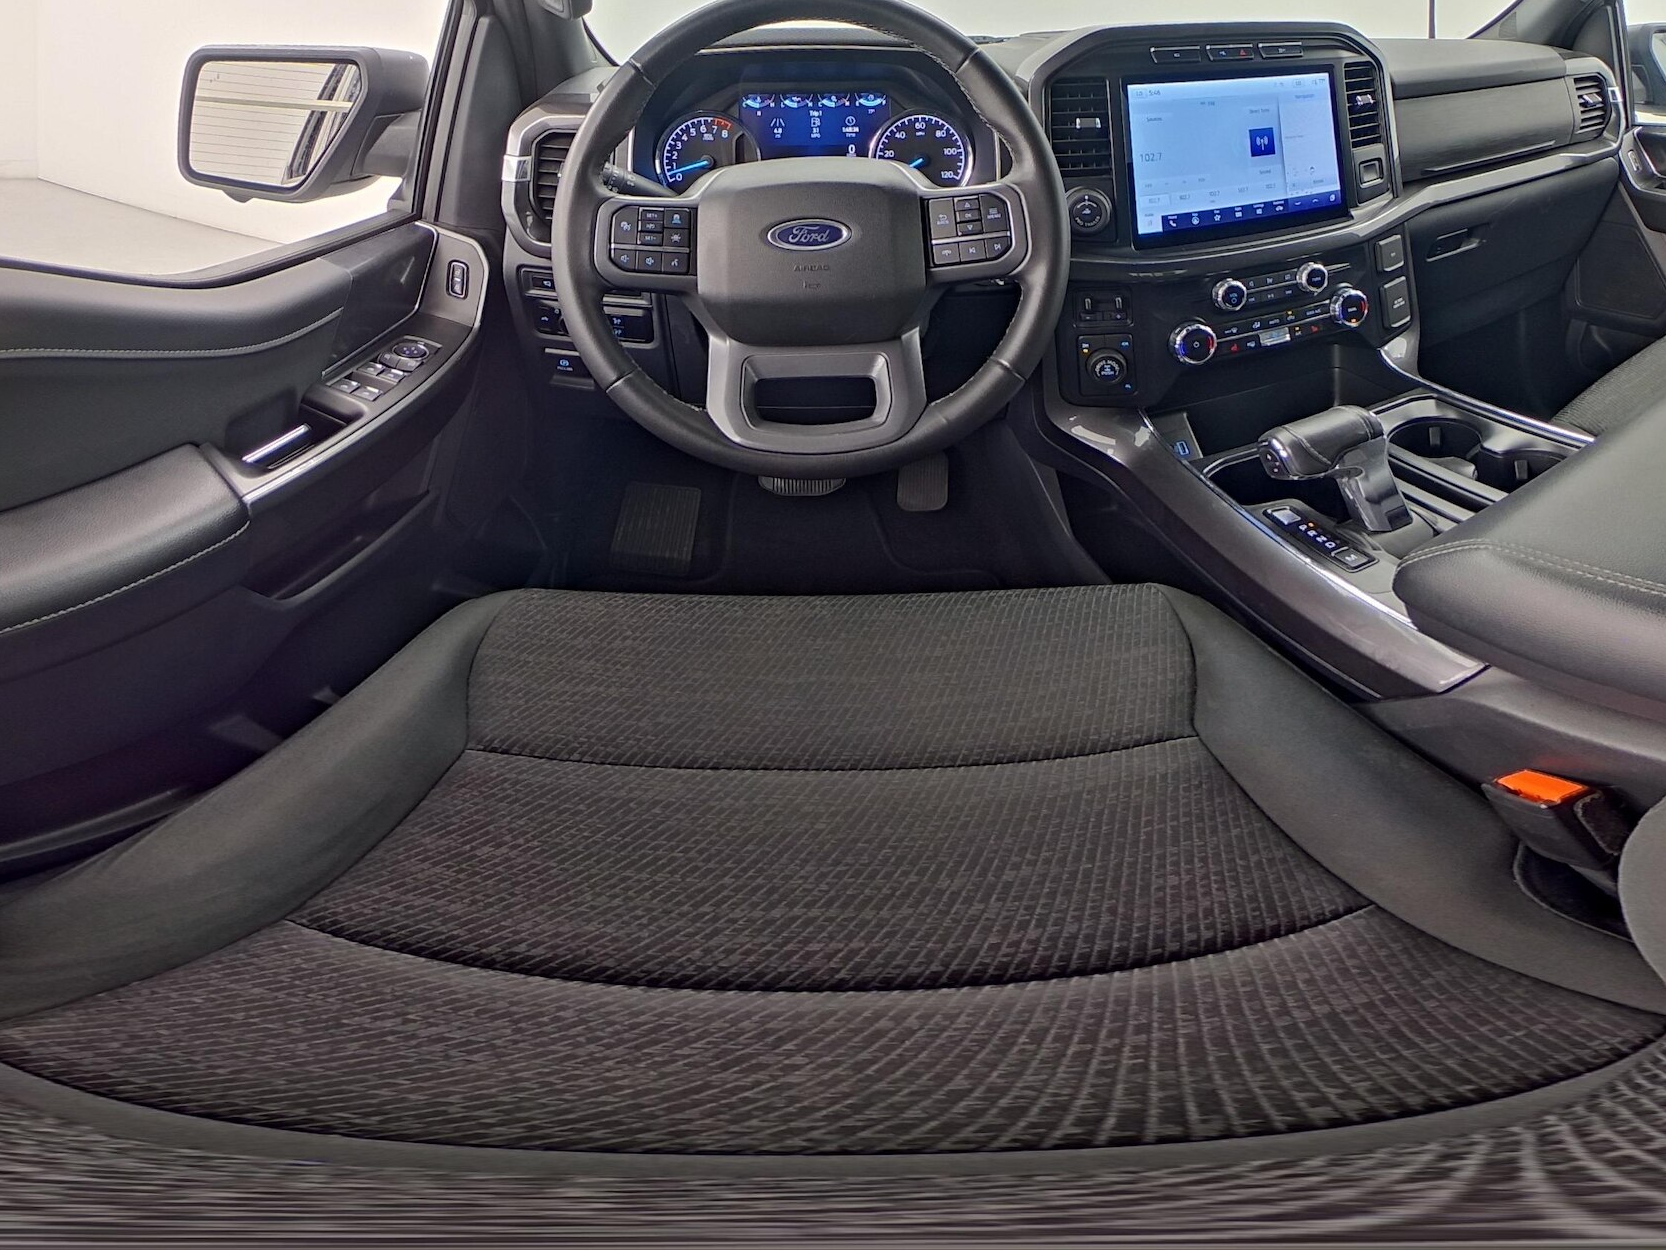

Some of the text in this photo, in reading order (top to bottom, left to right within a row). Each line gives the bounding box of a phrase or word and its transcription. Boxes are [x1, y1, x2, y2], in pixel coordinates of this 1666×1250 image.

[689, 128, 696, 136] 5
[700, 125, 707, 133] 6
[711, 125, 718, 134] 7
[681, 133, 688, 141] 4
[721, 130, 728, 138] 8
[676, 141, 682, 149] 3
[848, 144, 855, 154] 0
[672, 151, 678, 159] 2
[884, 150, 894, 158] 20
[1140, 152, 1162, 162] 102.7
[788, 225, 830, 243] Ford
